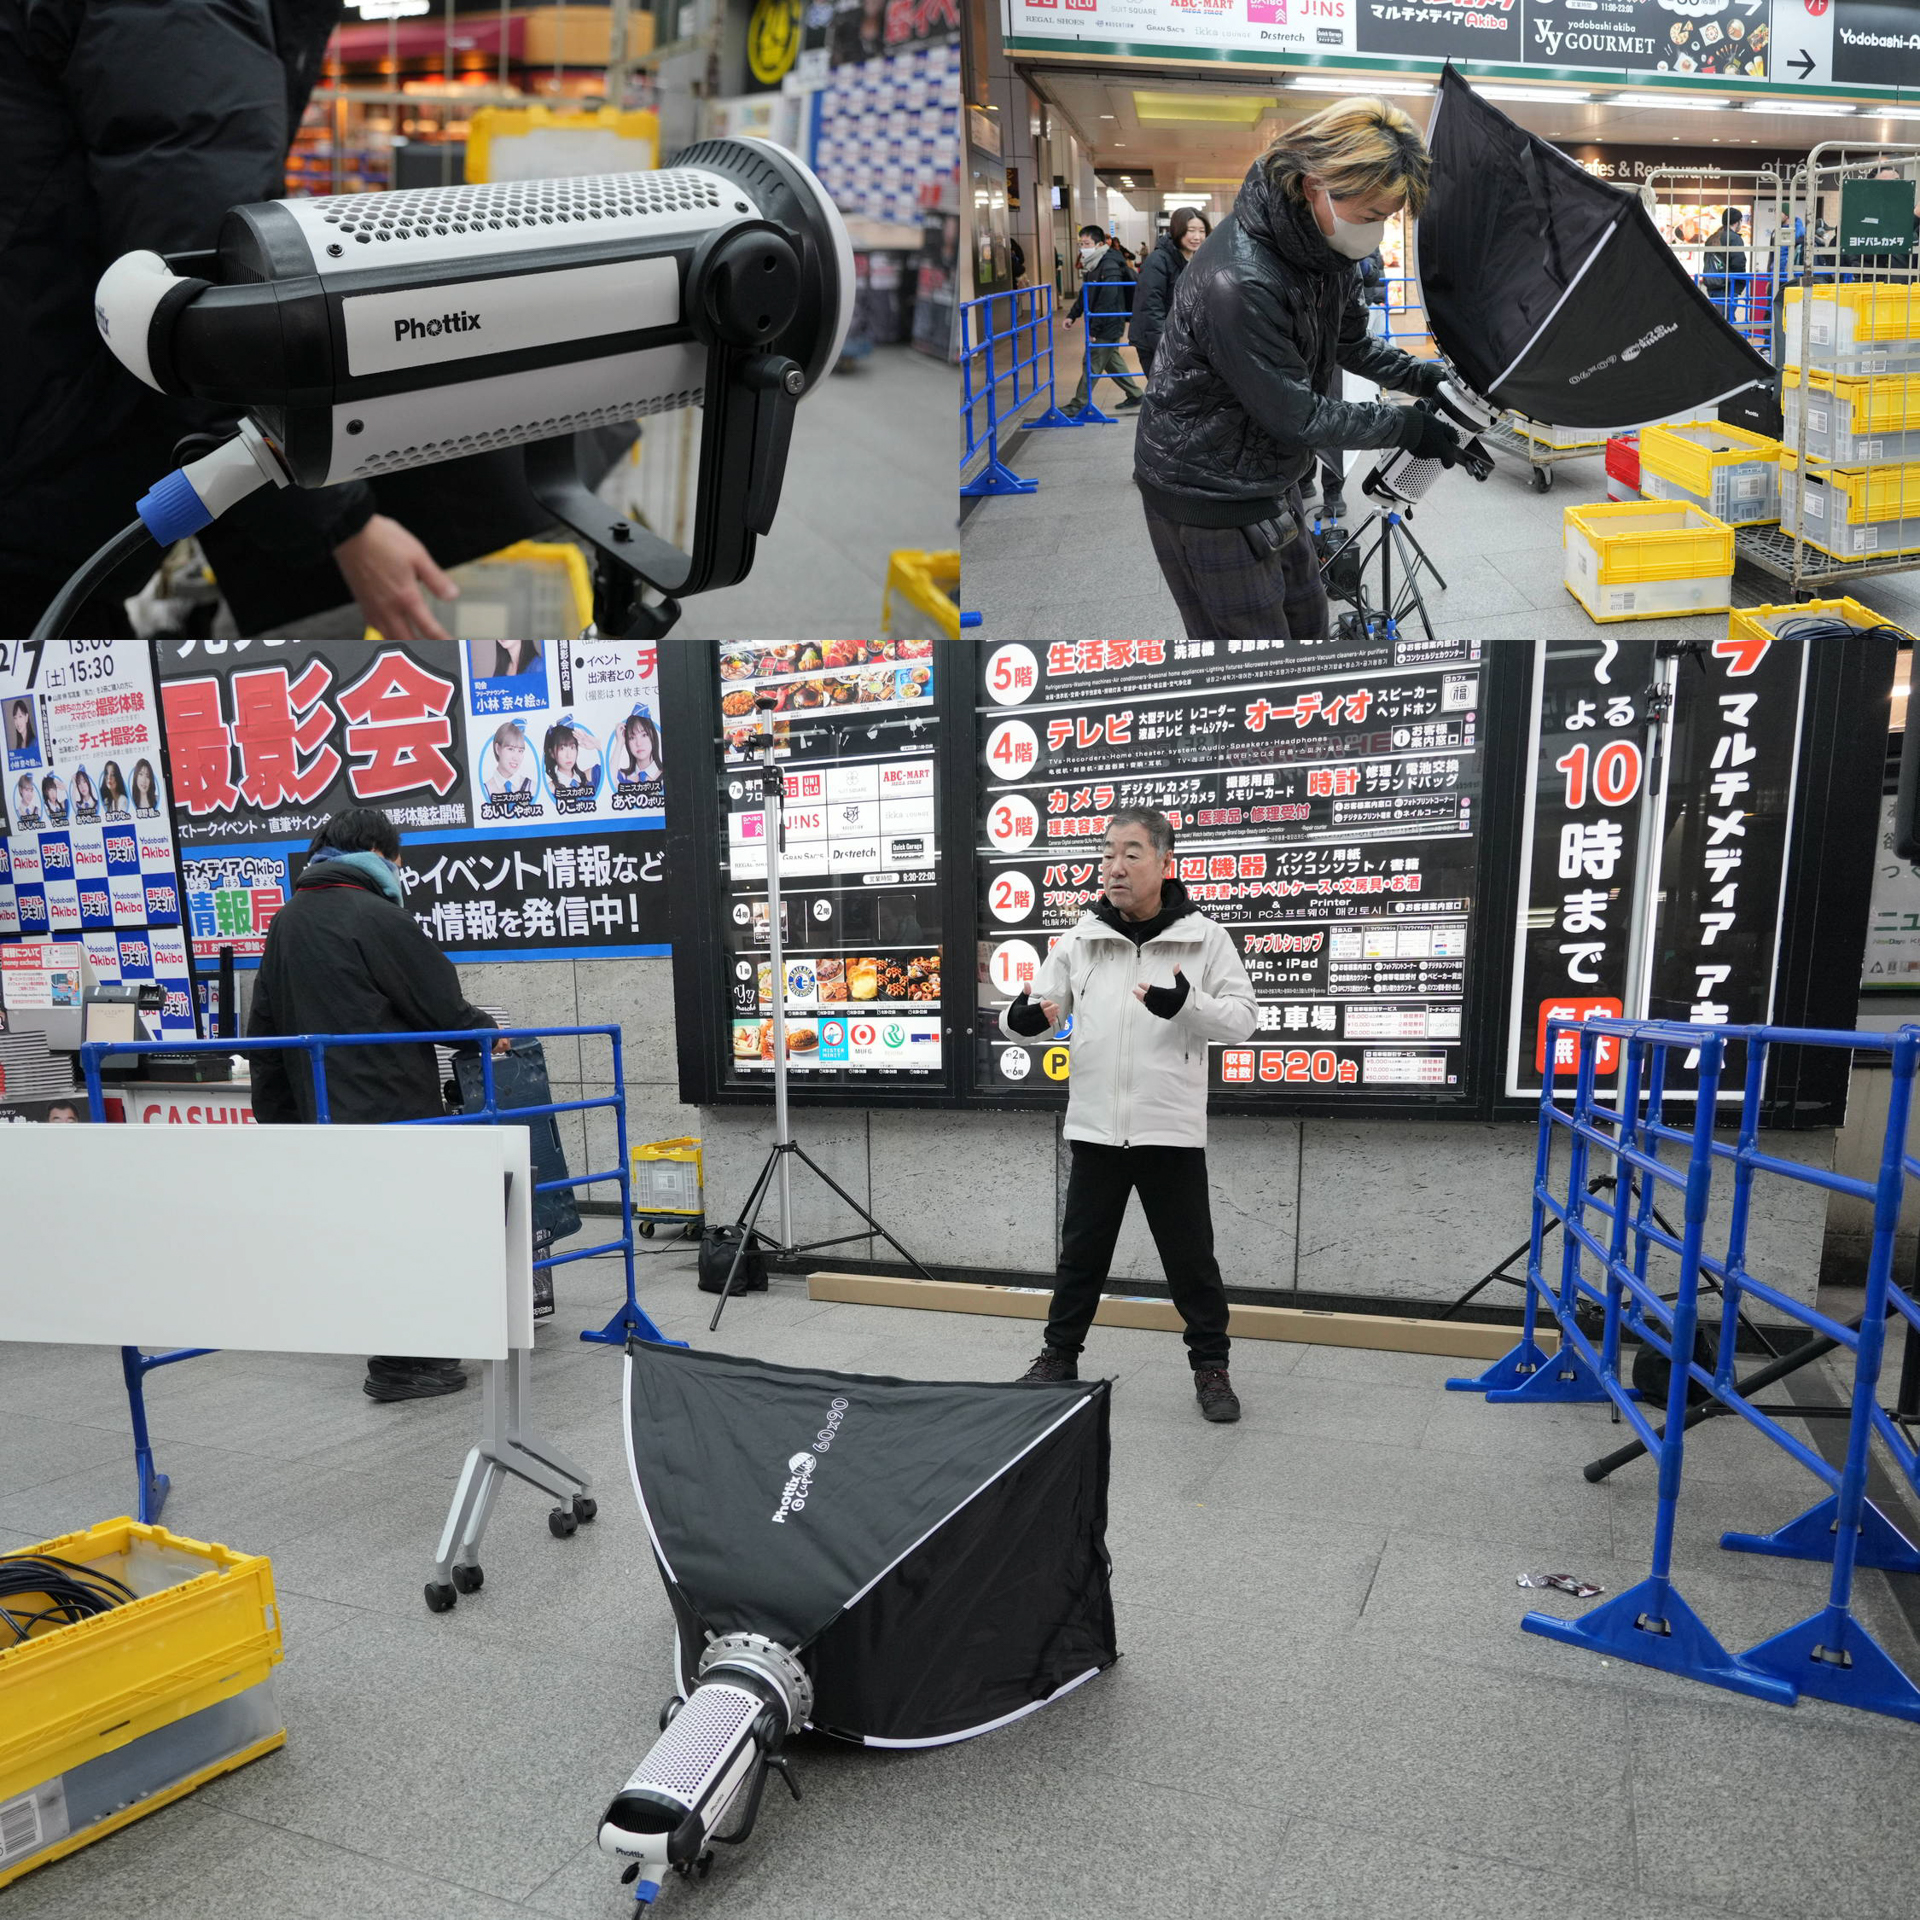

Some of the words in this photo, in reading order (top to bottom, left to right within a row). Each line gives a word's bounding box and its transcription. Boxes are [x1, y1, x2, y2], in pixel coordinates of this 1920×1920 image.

[1025, 15, 1053, 24] REGAL
[1057, 17, 1085, 26] SHOES
[1146, 24, 1166, 32] GRAN
[1567, 20, 1612, 32] yodobashi
[1613, 22, 1636, 33] akiba
[1564, 31, 1656, 55] GOURMET
[1618, 160, 1631, 177] &
[1849, 236, 1905, 247] ヨドバシカメラ
[394, 310, 482, 342] Phottix
[1047, 640, 1165, 677] 生活家電
[1173, 642, 1215, 660] 洗濯機
[69, 654, 115, 683] 15:30
[587, 653, 622, 668] イベント
[587, 668, 635, 685] 出演者との
[993, 656, 1033, 691] 5階
[1377, 686, 1438, 702] スピーカー
[1453, 685, 1468, 701] 福
[476, 698, 500, 713] 小林
[501, 693, 547, 711] 奈々絵さん
[1245, 688, 1373, 732] オーディオ
[1376, 702, 1437, 718] ヘッドホン
[1138, 707, 1183, 726] 大型テレビ
[1190, 704, 1236, 721] レコーダー
[78, 723, 149, 751] チェキ撮影会
[1047, 710, 1134, 752] テレビ
[1138, 723, 1183, 741] 液晶テレビ
[1189, 720, 1235, 736] ホームシアター
[1411, 723, 1448, 737] お客様
[993, 731, 1033, 765] 4階
[1410, 733, 1460, 748] 案内窓口
[1135, 749, 1165, 757] theater
[882, 769, 930, 783] ABC-MART
[1366, 764, 1393, 778] 修理
[1406, 759, 1459, 777] 電池交換
[619, 782, 662, 793] ミニスカポリス
[804, 777, 819, 786] UNI
[1121, 778, 1200, 796] デジタルカメラ
[1226, 773, 1275, 789] 撮影用品
[1307, 766, 1361, 797] 時計
[1366, 774, 1458, 793] ブランドバッグ
[491, 793, 532, 803] ミニスカポリス
[555, 787, 595, 798] ミニスカポリス
[804, 786, 819, 796] QLO
[1225, 785, 1295, 801] メモリーカード
[557, 798, 596, 814] りこポリス
[612, 794, 665, 810] あやのポリス
[1047, 785, 1115, 814] カメラ
[1120, 791, 1216, 809] デジタル一眼レフカメラ
[1402, 808, 1454, 818] ネイルコーナー
[1700, 693, 1758, 947] マルチメディア
[994, 806, 1034, 838] 3階
[73, 841, 102, 851] Yodobashi
[106, 836, 135, 850] ヨドバシ
[139, 836, 169, 845] Yodobashi
[42, 843, 69, 855] ヨドバシ
[108, 848, 136, 863] アキバ
[141, 846, 170, 859] Akiba
[1276, 849, 1319, 864] インク
[1332, 847, 1361, 861] 用紙
[13, 857, 39, 869] Akiba
[44, 854, 71, 869] アキバ
[75, 851, 103, 865] Akiba
[400, 845, 665, 896] やイベント情報など
[1043, 863, 1104, 888] パソ
[1275, 859, 1376, 878] パソコンソフト
[1390, 857, 1420, 871] 書籍
[224, 878, 239, 888] ほう
[19, 895, 44, 908] ヨドバシ
[48, 895, 76, 904] Yodobashi
[80, 891, 109, 904] ヨドバシ
[112, 890, 142, 900] Yodobashi
[146, 887, 174, 900] ヨドバシ
[994, 880, 1031, 909] 2階
[1043, 888, 1103, 907] プリンタ・
[51, 905, 78, 918] Akiba
[83, 903, 109, 917] アキバ
[114, 901, 143, 914] Akiba
[148, 899, 176, 913] アキバ
[1271, 900, 1281, 909] &
[1310, 898, 1352, 908] Printer
[21, 906, 46, 921] アキバ
[186, 888, 284, 938] 情報局
[1042, 909, 1058, 918] PC
[1210, 911, 1252, 921] 주변기기
[1258, 907, 1329, 920] PC소프트웨어
[1335, 905, 1382, 917] 매킨토시
[86, 944, 116, 953] Yodobashi
[120, 941, 148, 954] ヨドバシ
[152, 941, 183, 951] Yodobashi
[1243, 931, 1325, 954] アップルショップ
[89, 954, 117, 967] Akiba
[122, 951, 150, 967] アキバ
[155, 951, 184, 964] Akiba
[998, 951, 1034, 983] 1階
[1251, 971, 1313, 982] Phone
[162, 1001, 190, 1017] アキバ
[1256, 1004, 1337, 1032] 駐車場
[1051, 1053, 1068, 1075] P
[1226, 1053, 1252, 1065] 収容
[1260, 1050, 1359, 1083] 520台
[1226, 1066, 1252, 1079] 台数
[812, 1397, 849, 1453] 60x90
[771, 1474, 802, 1524] Phottix
[615, 1846, 645, 1859] Phottix
